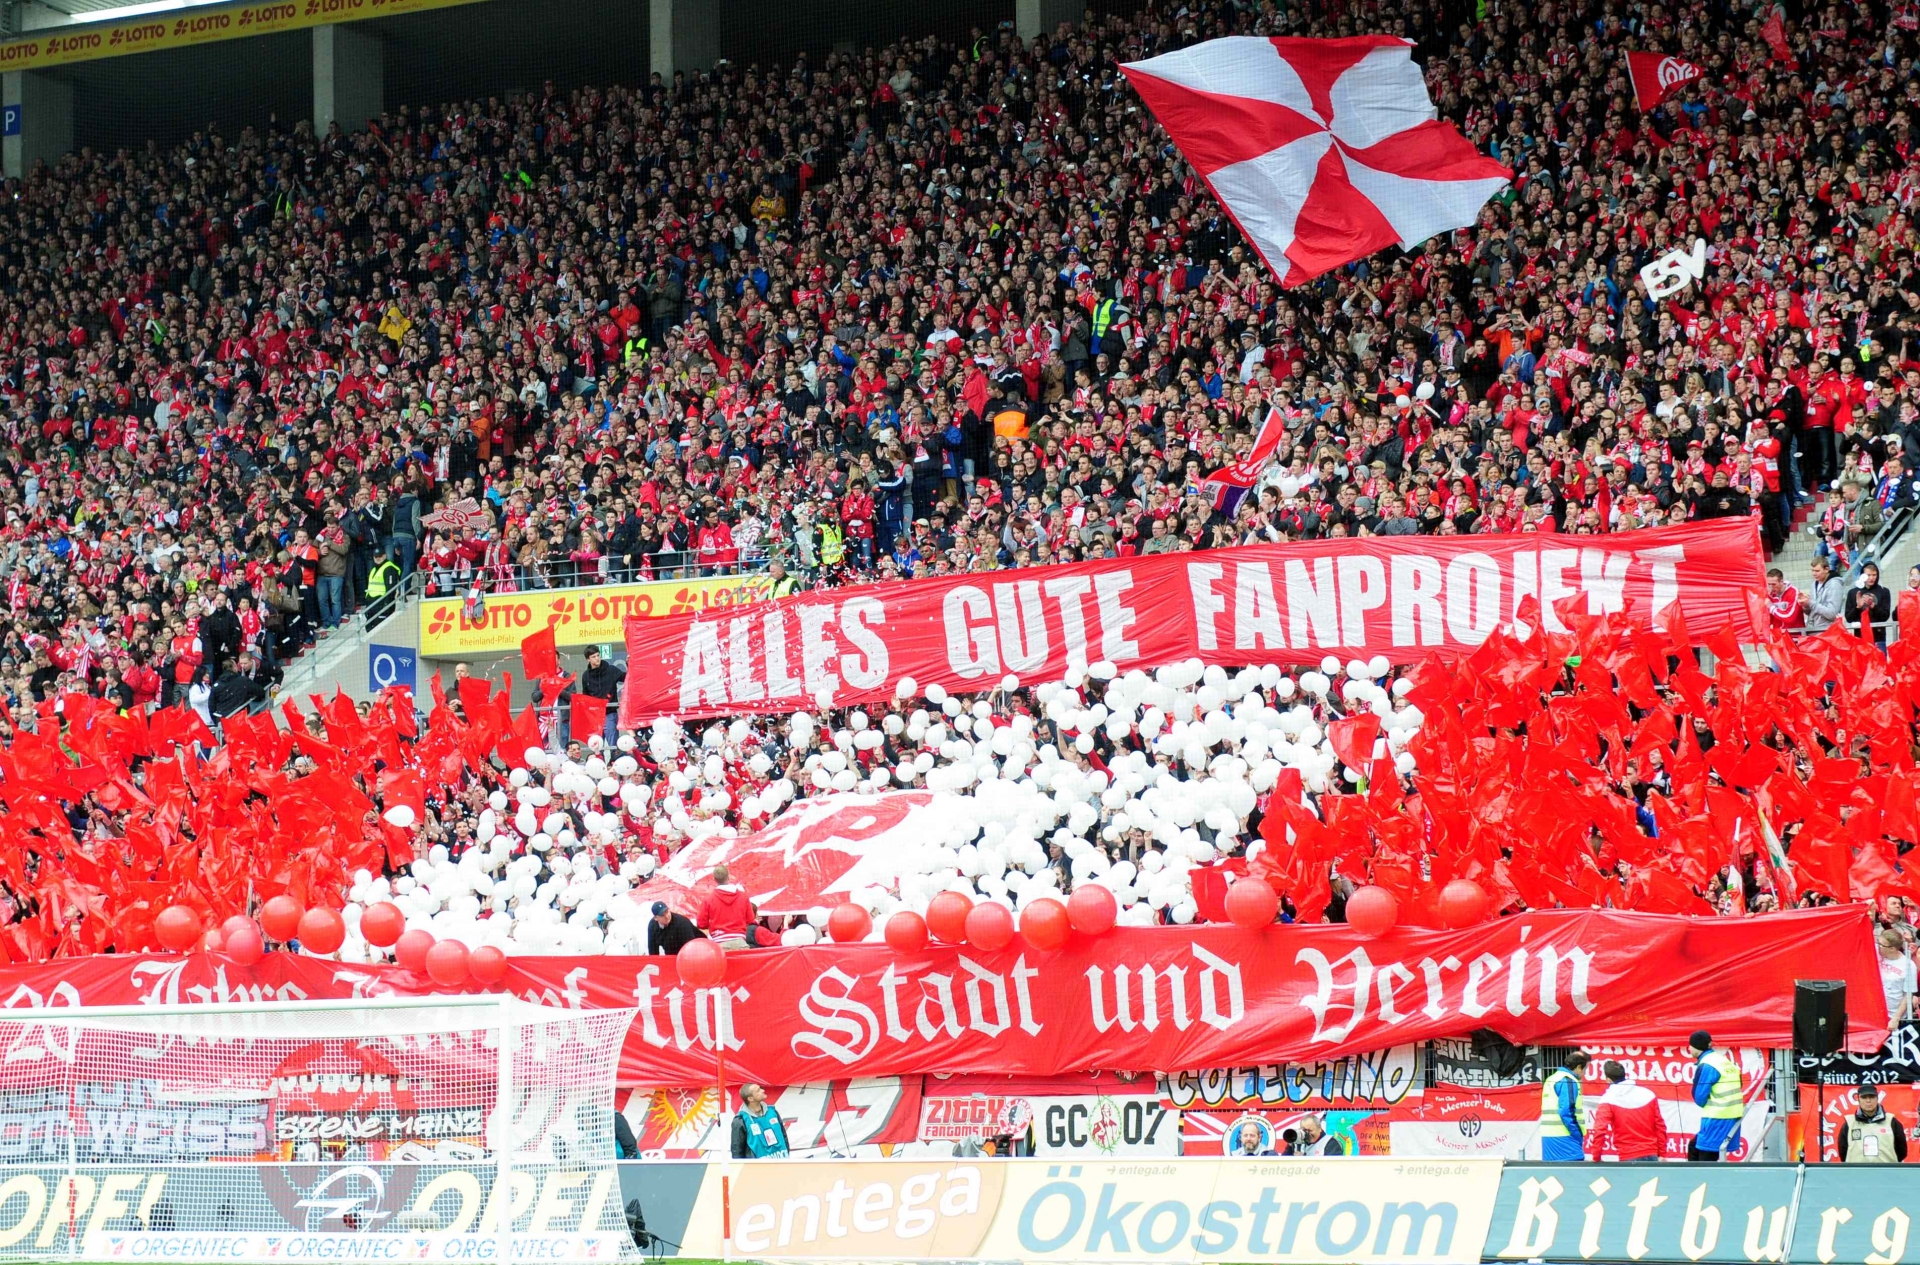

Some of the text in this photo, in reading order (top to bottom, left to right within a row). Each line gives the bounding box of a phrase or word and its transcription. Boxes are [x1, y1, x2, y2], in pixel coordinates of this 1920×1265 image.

[256, 4, 296, 22] LOTTO
[190, 14, 230, 32] LOTTO
[126, 24, 165, 42] LOTTO
[0, 43, 38, 61] LOTTO
[62, 34, 102, 52] LOTTO
[5, 110, 16, 132] P
[459, 603, 532, 631] LOTTO
[579, 594, 654, 622] LOTTO
[579, 627, 624, 637] Rheinland-P
[680, 543, 1685, 708] ALLES GUTE FANPROJEKT
[459, 634, 515, 646] Rheinland-Pfalz
[791, 953, 1043, 1065] Stadt
[1084, 941, 1244, 1034] und
[1294, 925, 1598, 1045] Verein
[1824, 1070, 1900, 1085] since 2012
[1484, 1099, 1506, 1114] Bube
[1046, 1104, 1088, 1147] GC
[1124, 1101, 1167, 1145] 07
[1118, 1164, 1177, 1177] entega.de
[1260, 1164, 1320, 1177] entega.de
[1406, 1164, 1469, 1177] entega.de
[734, 1164, 982, 1253] entega
[1017, 1165, 1458, 1256] Ökostrom
[1496, 1175, 1911, 1265] Bitburg
[131, 1236, 249, 1258] ORGENTEC
[286, 1237, 403, 1259] ORGENTEC
[443, 1238, 569, 1259] ORGNTEC
